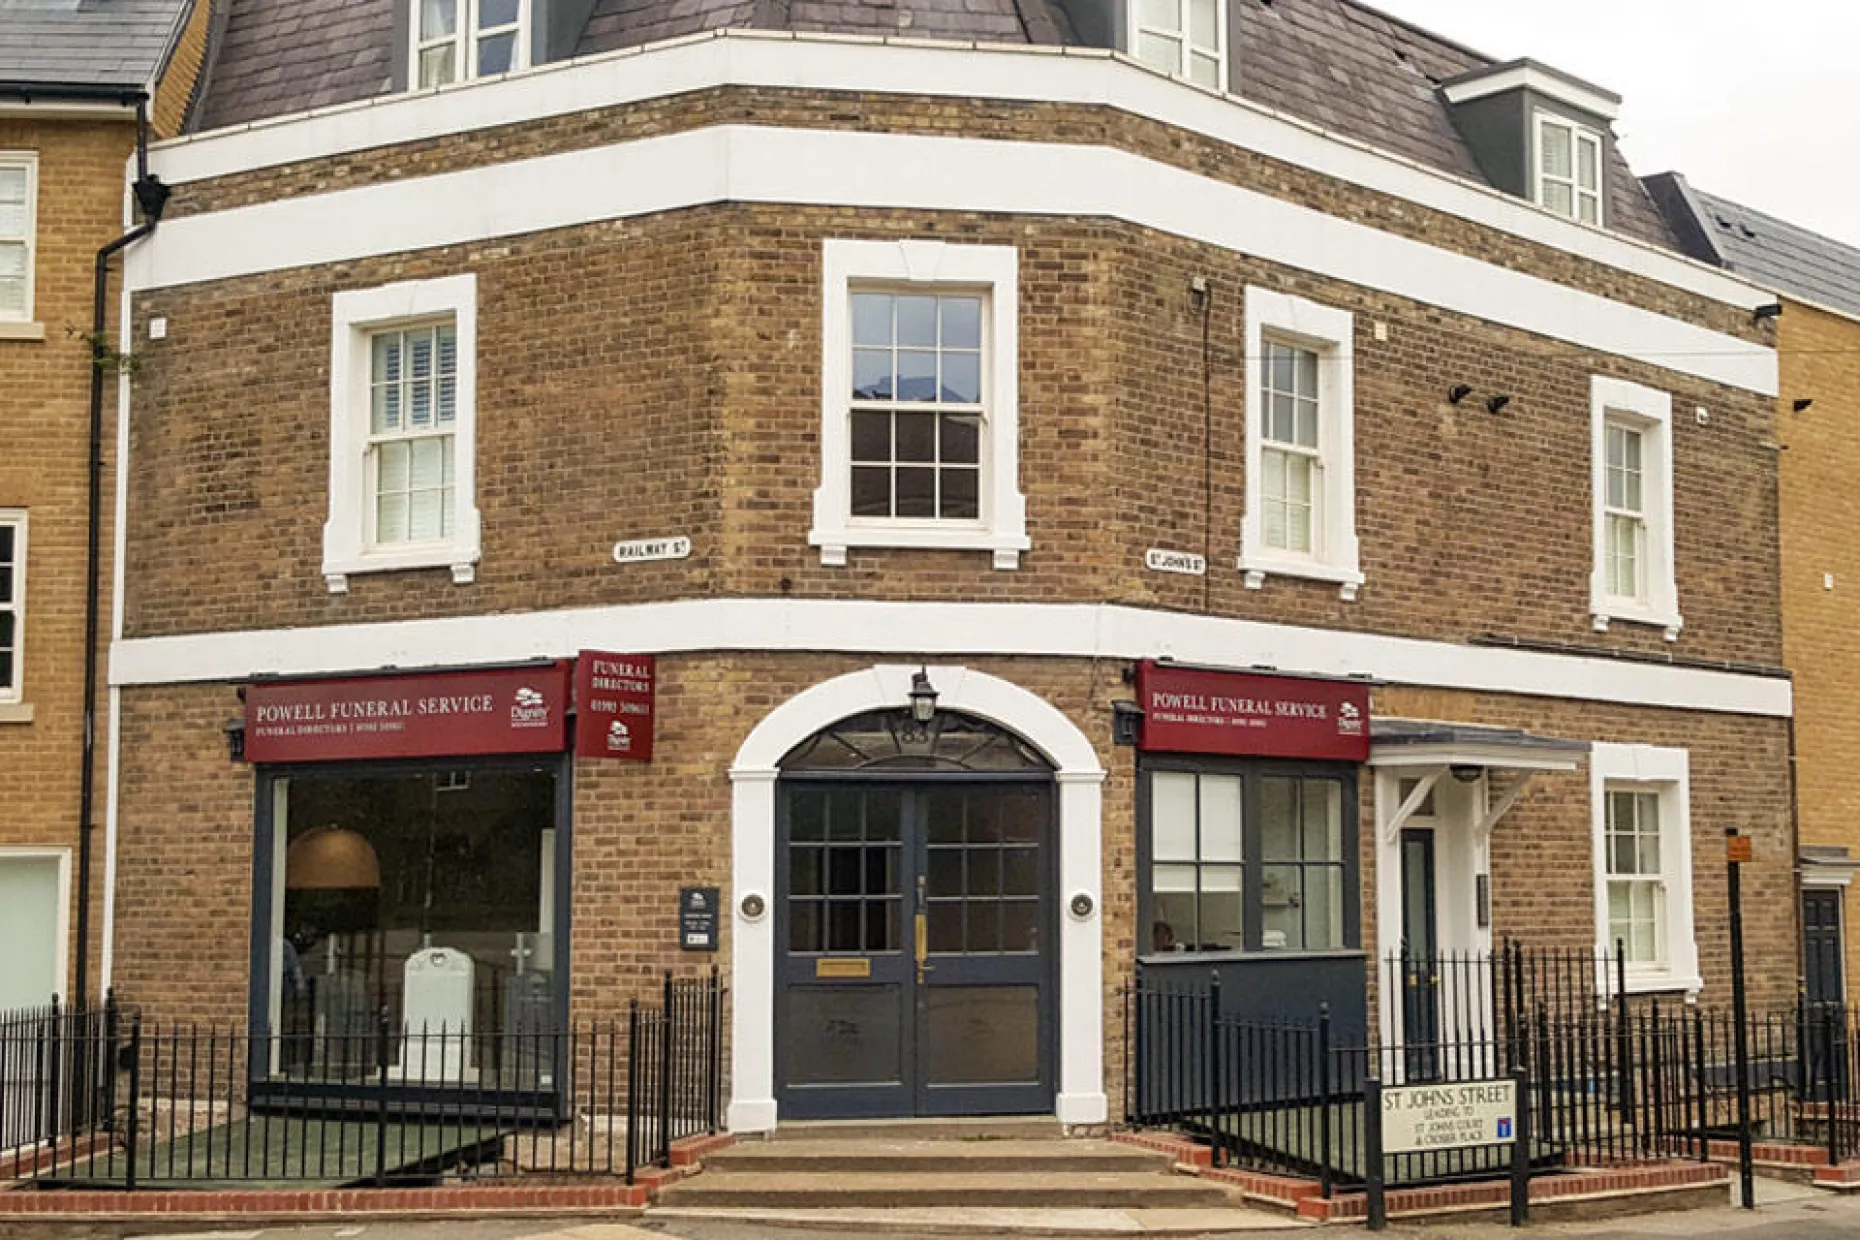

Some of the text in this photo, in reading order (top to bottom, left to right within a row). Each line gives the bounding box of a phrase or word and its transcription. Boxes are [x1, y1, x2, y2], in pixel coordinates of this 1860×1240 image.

[619, 542, 667, 558] RAILWAY
[593, 660, 650, 678] FUNERAL
[592, 675, 649, 692] DIRECTORS
[256, 694, 493, 722] POWELL FUNERAL SERVICE
[1152, 692, 1328, 719] POWELL FUNERAL SERVICE
[256, 725, 296, 736] FUNERAL
[298, 723, 348, 735] DIRECTORS
[1384, 1085, 1511, 1111] ST JOHNS STREET
[1425, 1105, 1474, 1120] LEADING TO
